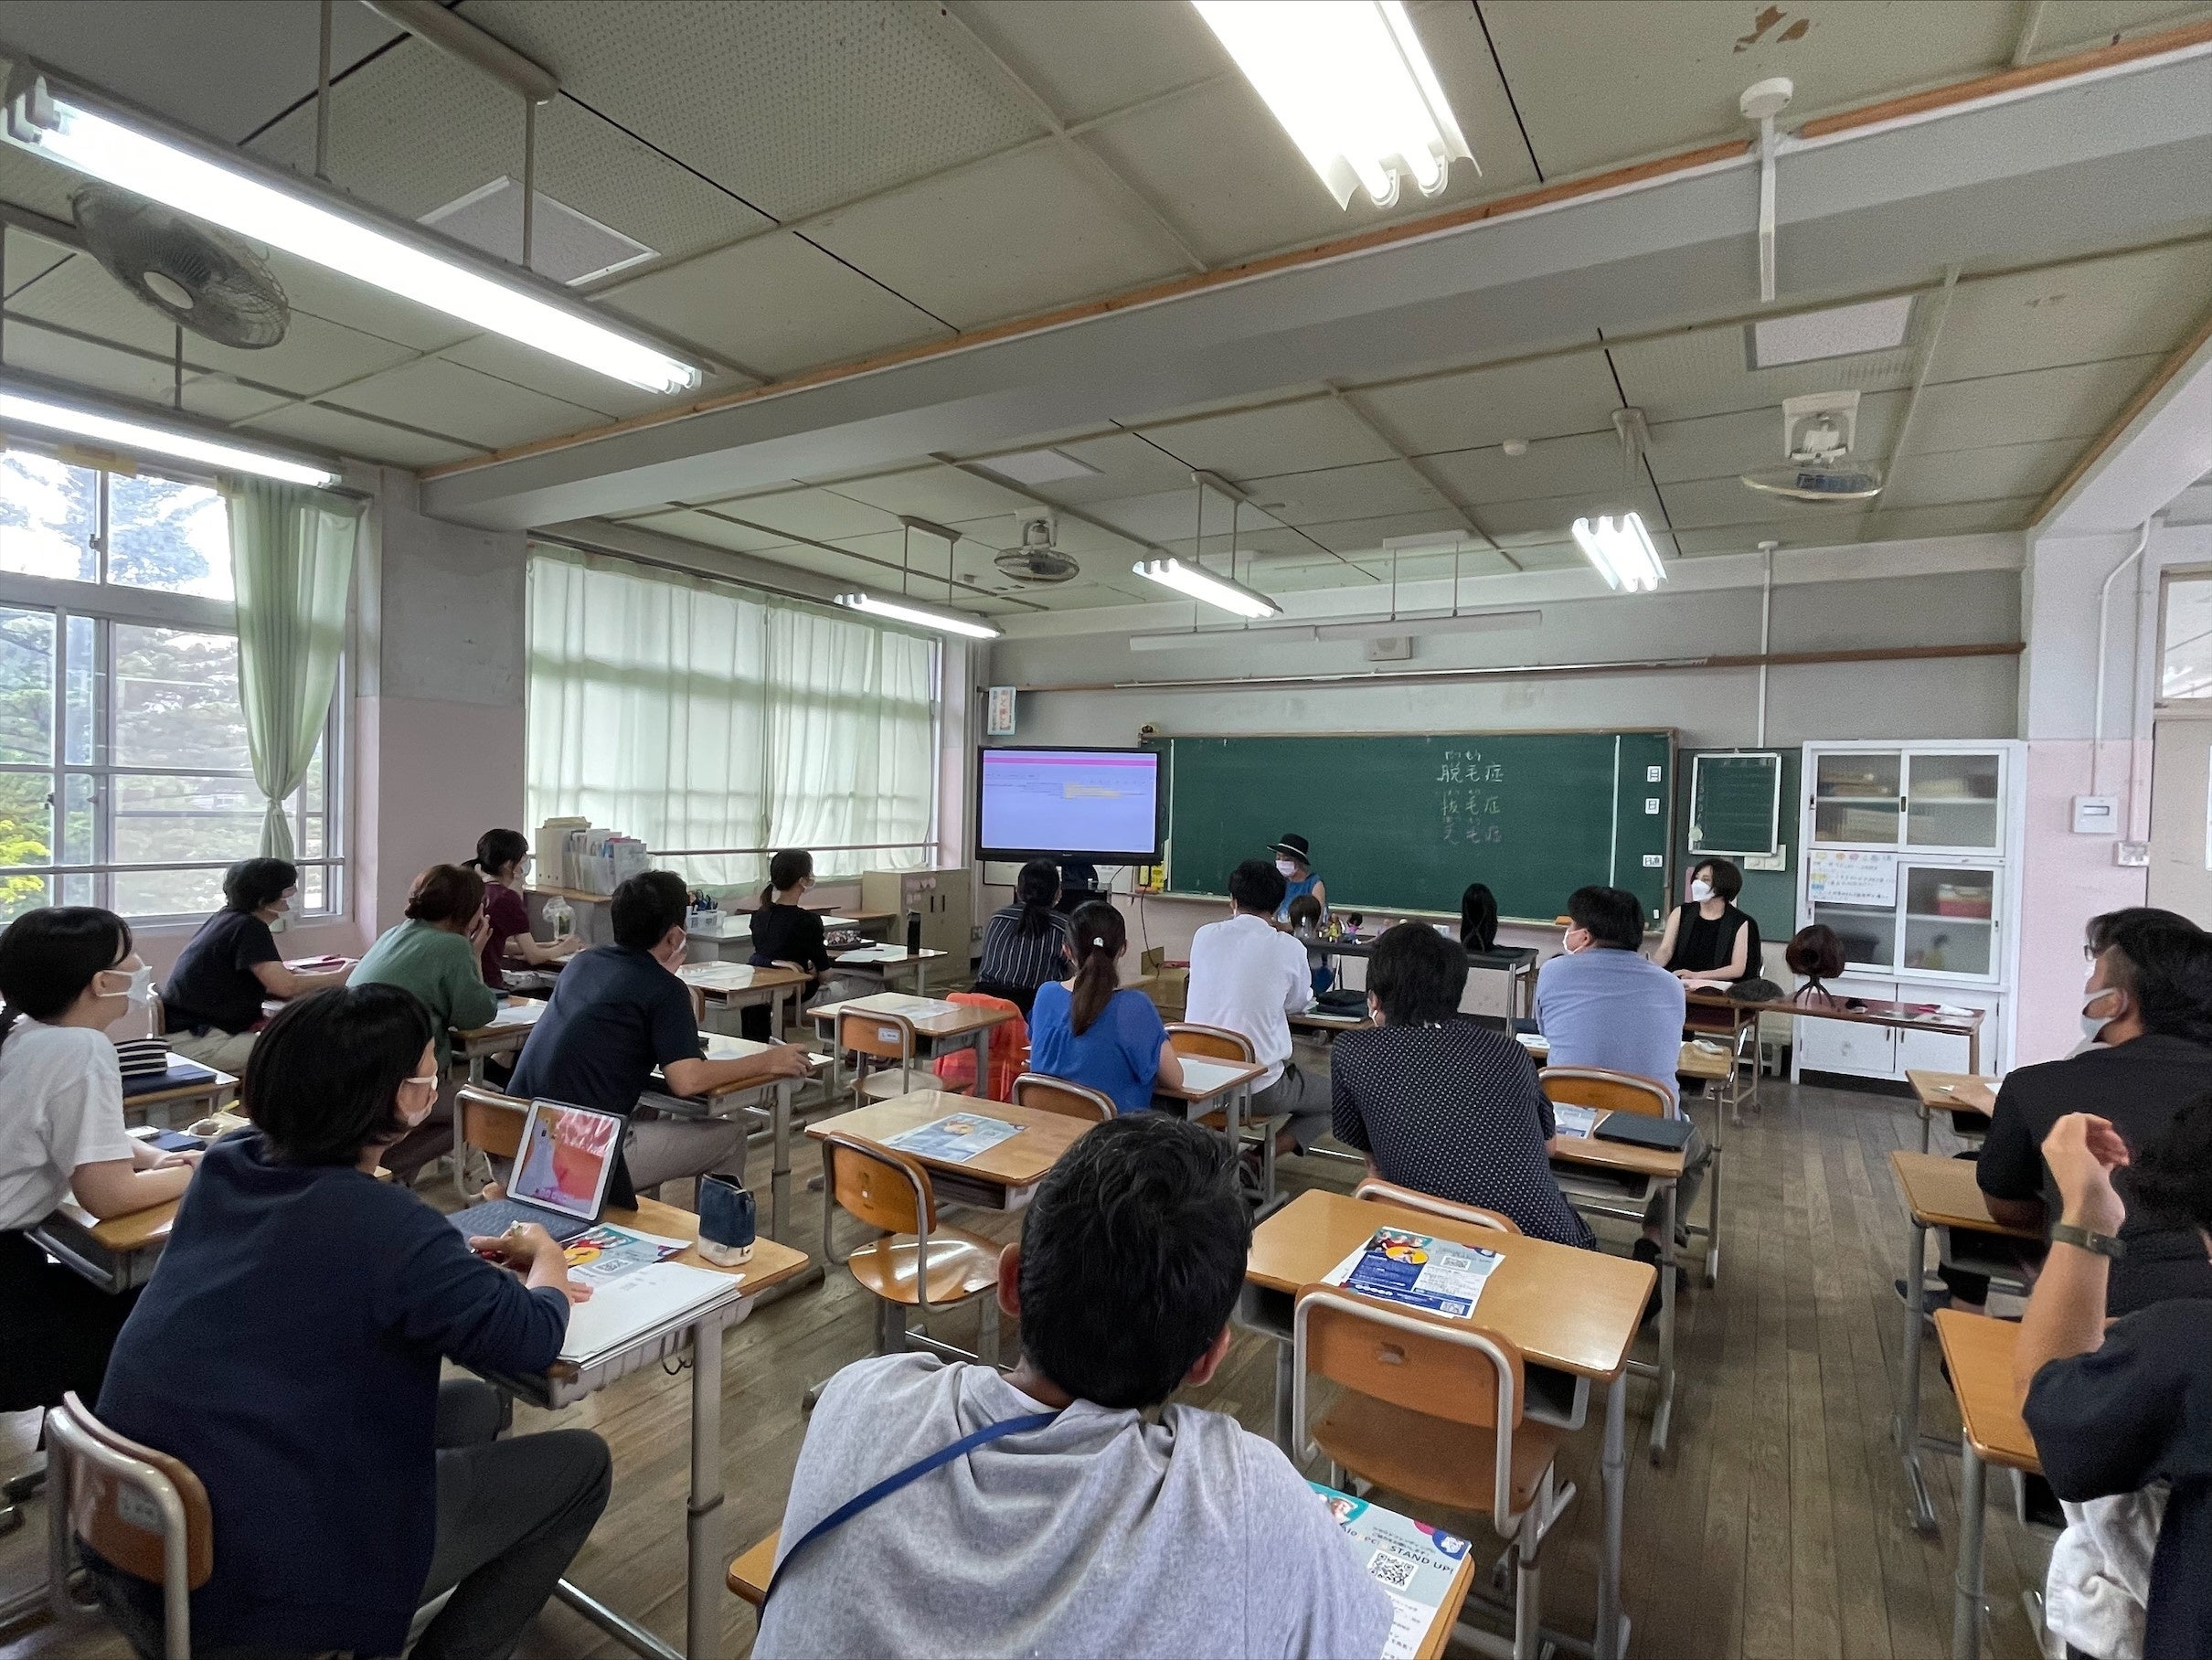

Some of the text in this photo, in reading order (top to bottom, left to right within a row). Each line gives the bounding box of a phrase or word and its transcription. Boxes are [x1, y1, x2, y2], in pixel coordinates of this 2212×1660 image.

[1437, 762, 1504, 783] 脱毛症
[1390, 1545, 1430, 1565] STAND
